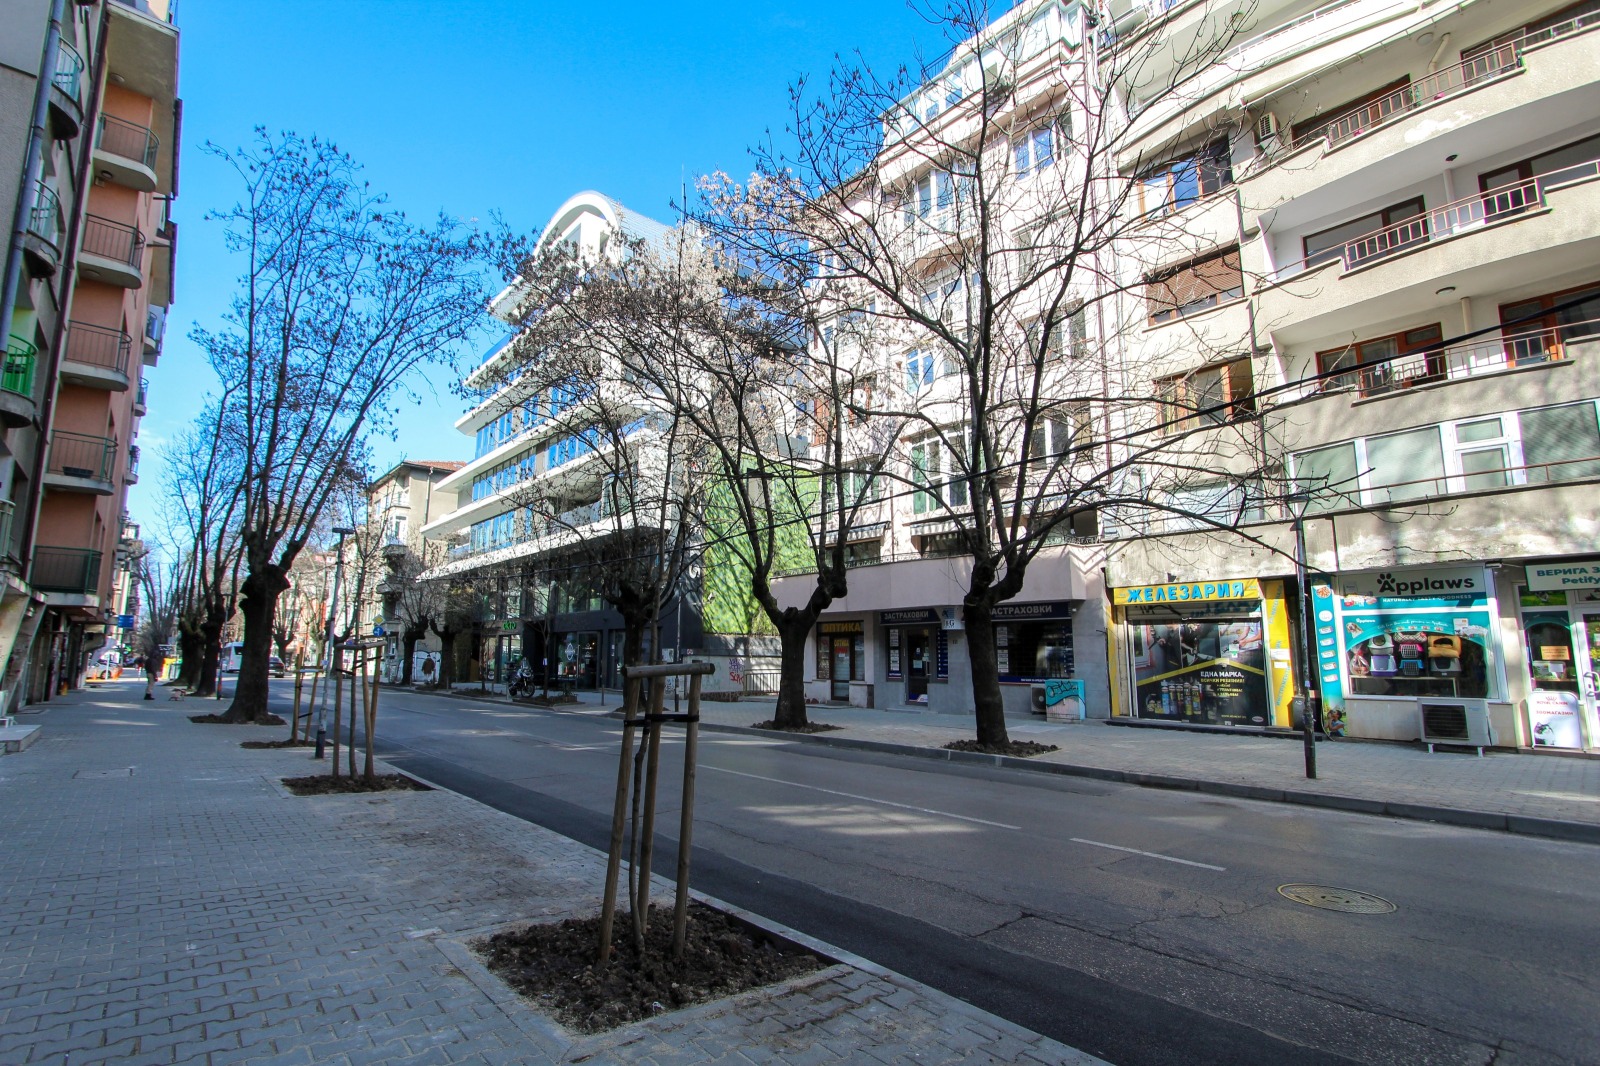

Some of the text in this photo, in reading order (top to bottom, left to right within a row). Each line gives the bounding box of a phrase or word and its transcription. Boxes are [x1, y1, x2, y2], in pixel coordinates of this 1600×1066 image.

[1536, 567, 1588, 577] ВЕРИГА
[1377, 573, 1475, 595] Applaws
[1127, 582, 1245, 603] ЖЕЛЕЗАРИЯ
[884, 610, 929, 620] ЗАСТРАХОВКИ
[822, 622, 861, 633] ОПТИКА
